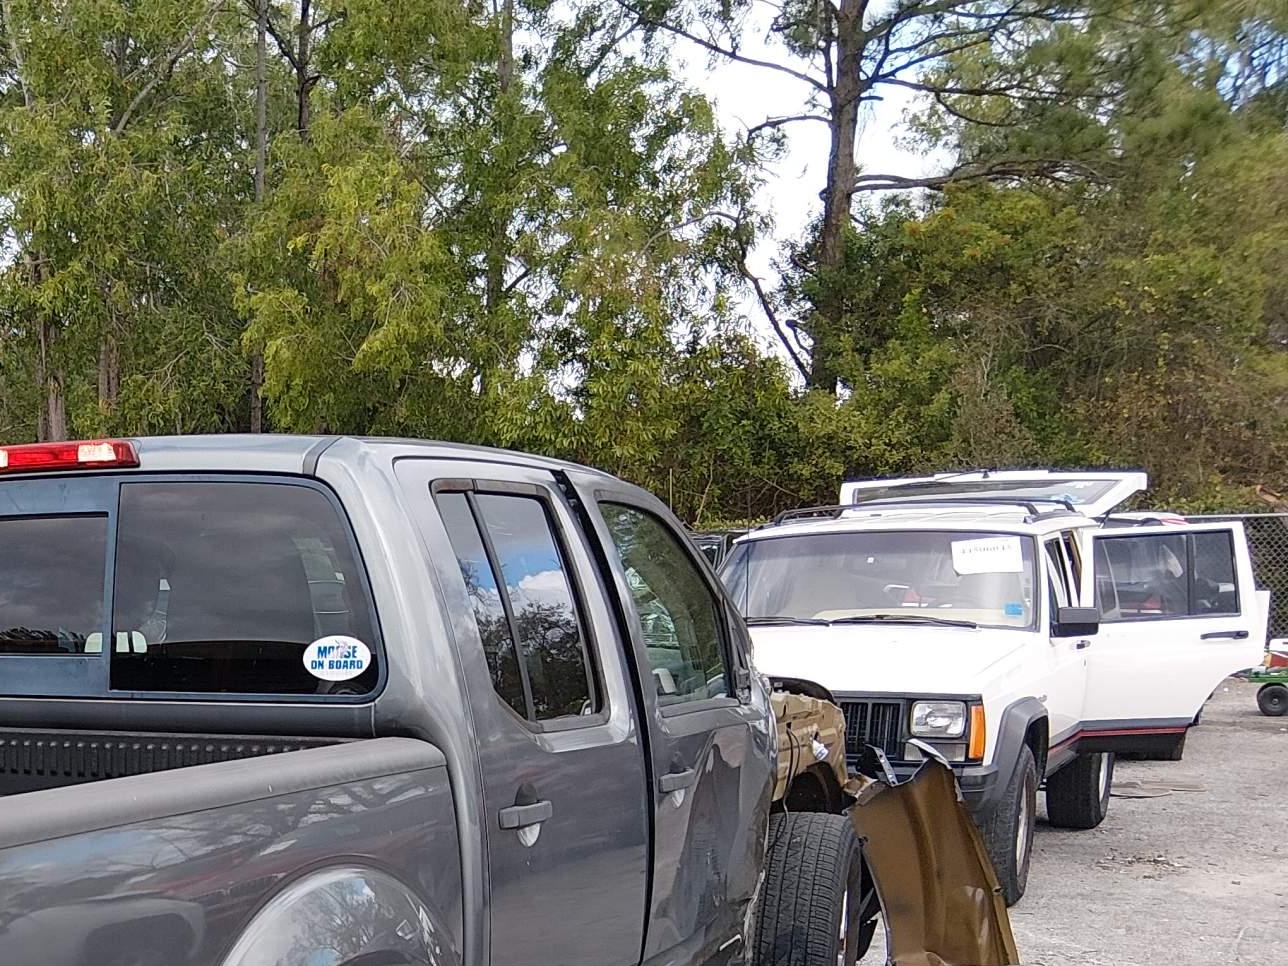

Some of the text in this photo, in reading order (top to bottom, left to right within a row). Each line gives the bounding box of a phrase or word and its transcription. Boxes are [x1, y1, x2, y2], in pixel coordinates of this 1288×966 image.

[317, 645, 357, 658] MOSE
[311, 660, 363, 670] ON BOARD
